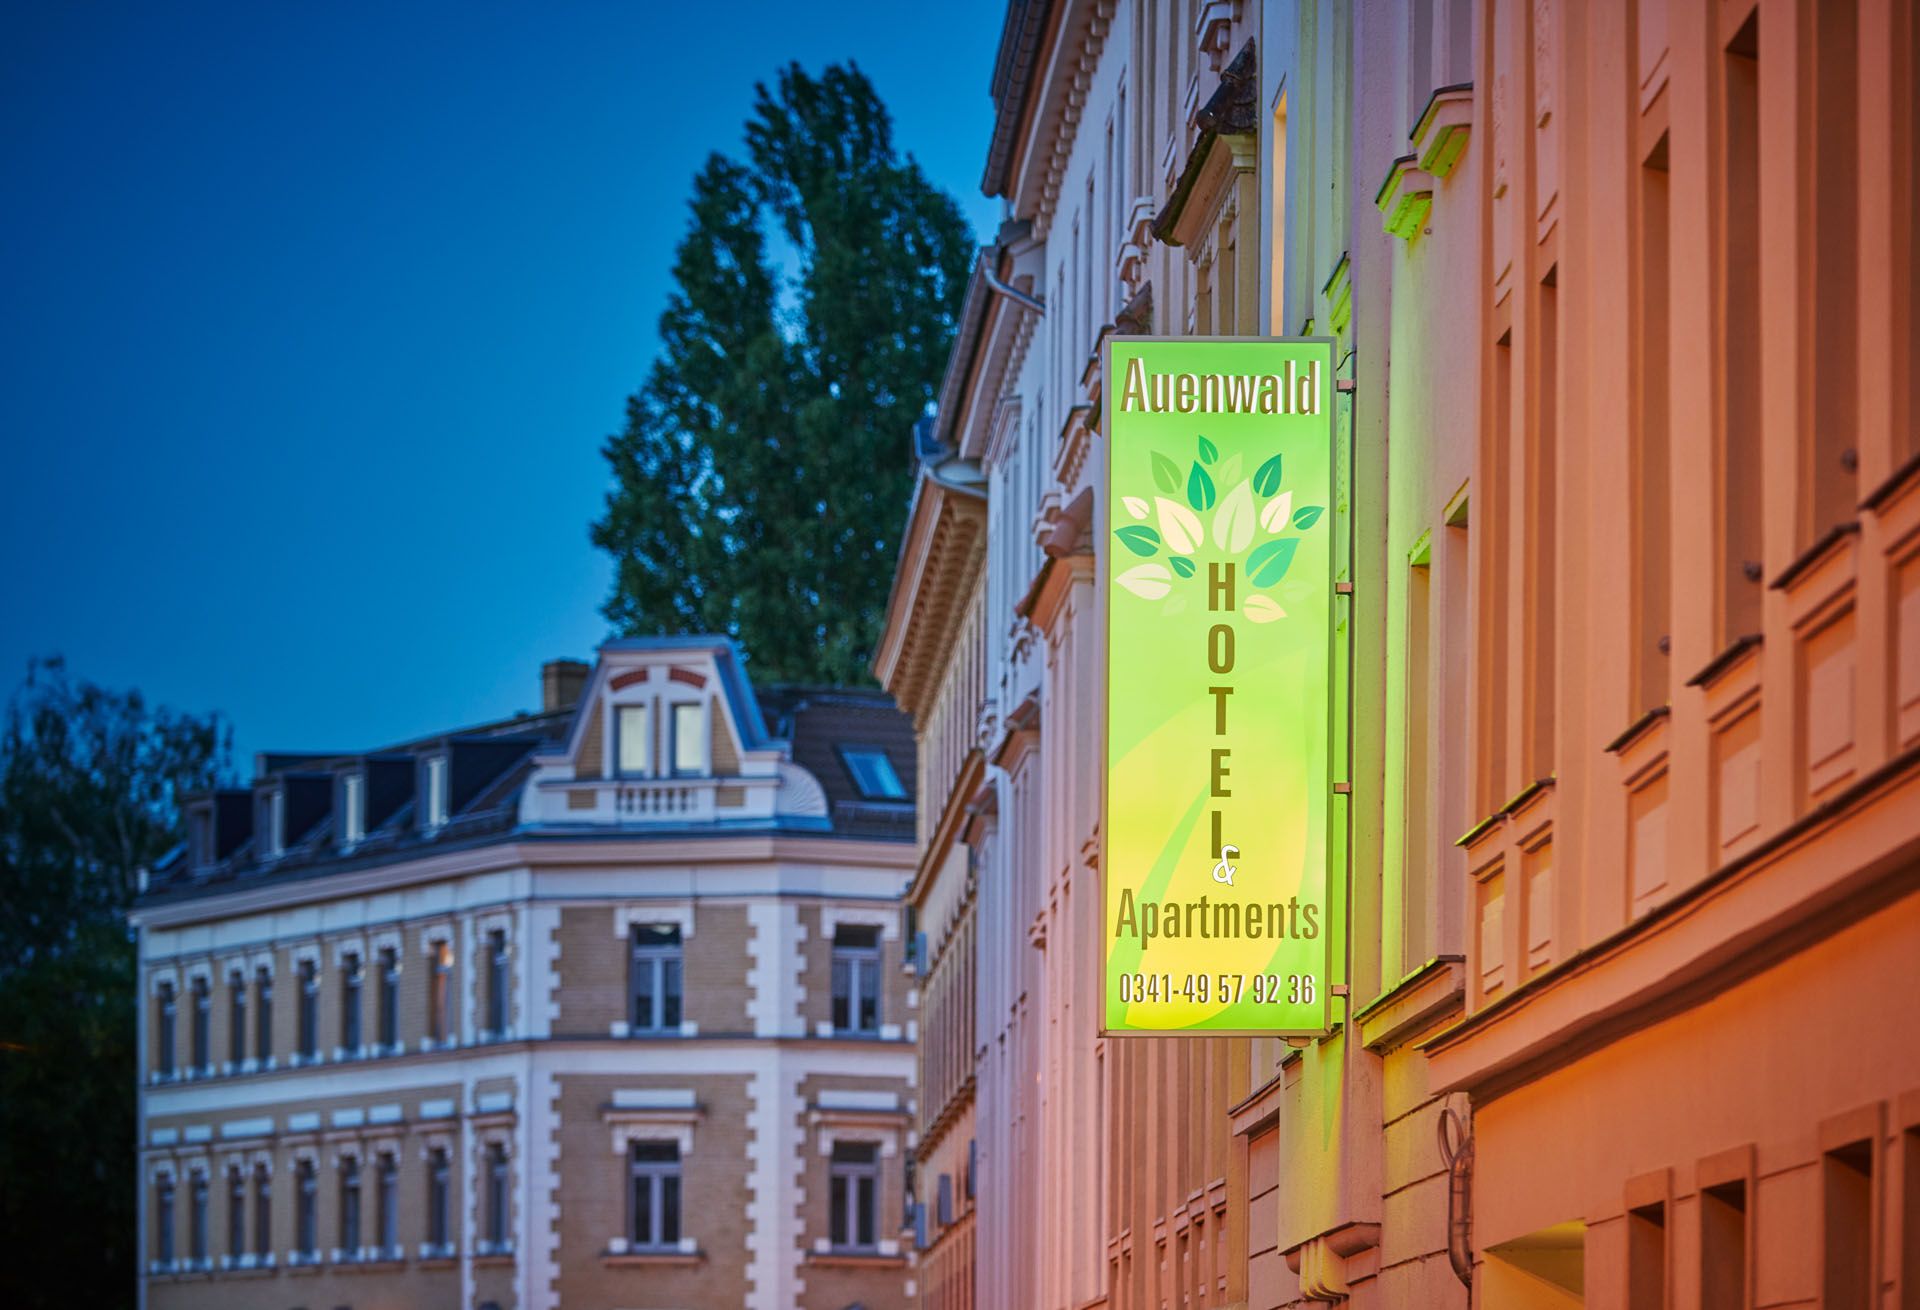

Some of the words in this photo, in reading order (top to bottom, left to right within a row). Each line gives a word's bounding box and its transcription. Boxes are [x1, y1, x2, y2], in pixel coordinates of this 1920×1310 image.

[1121, 358, 1321, 415] Auenwald
[1208, 562, 1240, 859] HOTEL
[1212, 844, 1239, 885] &
[1115, 888, 1319, 950] Apartments
[1119, 973, 1211, 1004] 0341-49
[1217, 974, 1244, 1004] 57
[1252, 974, 1280, 1004] 92
[1288, 974, 1316, 1004] 36
